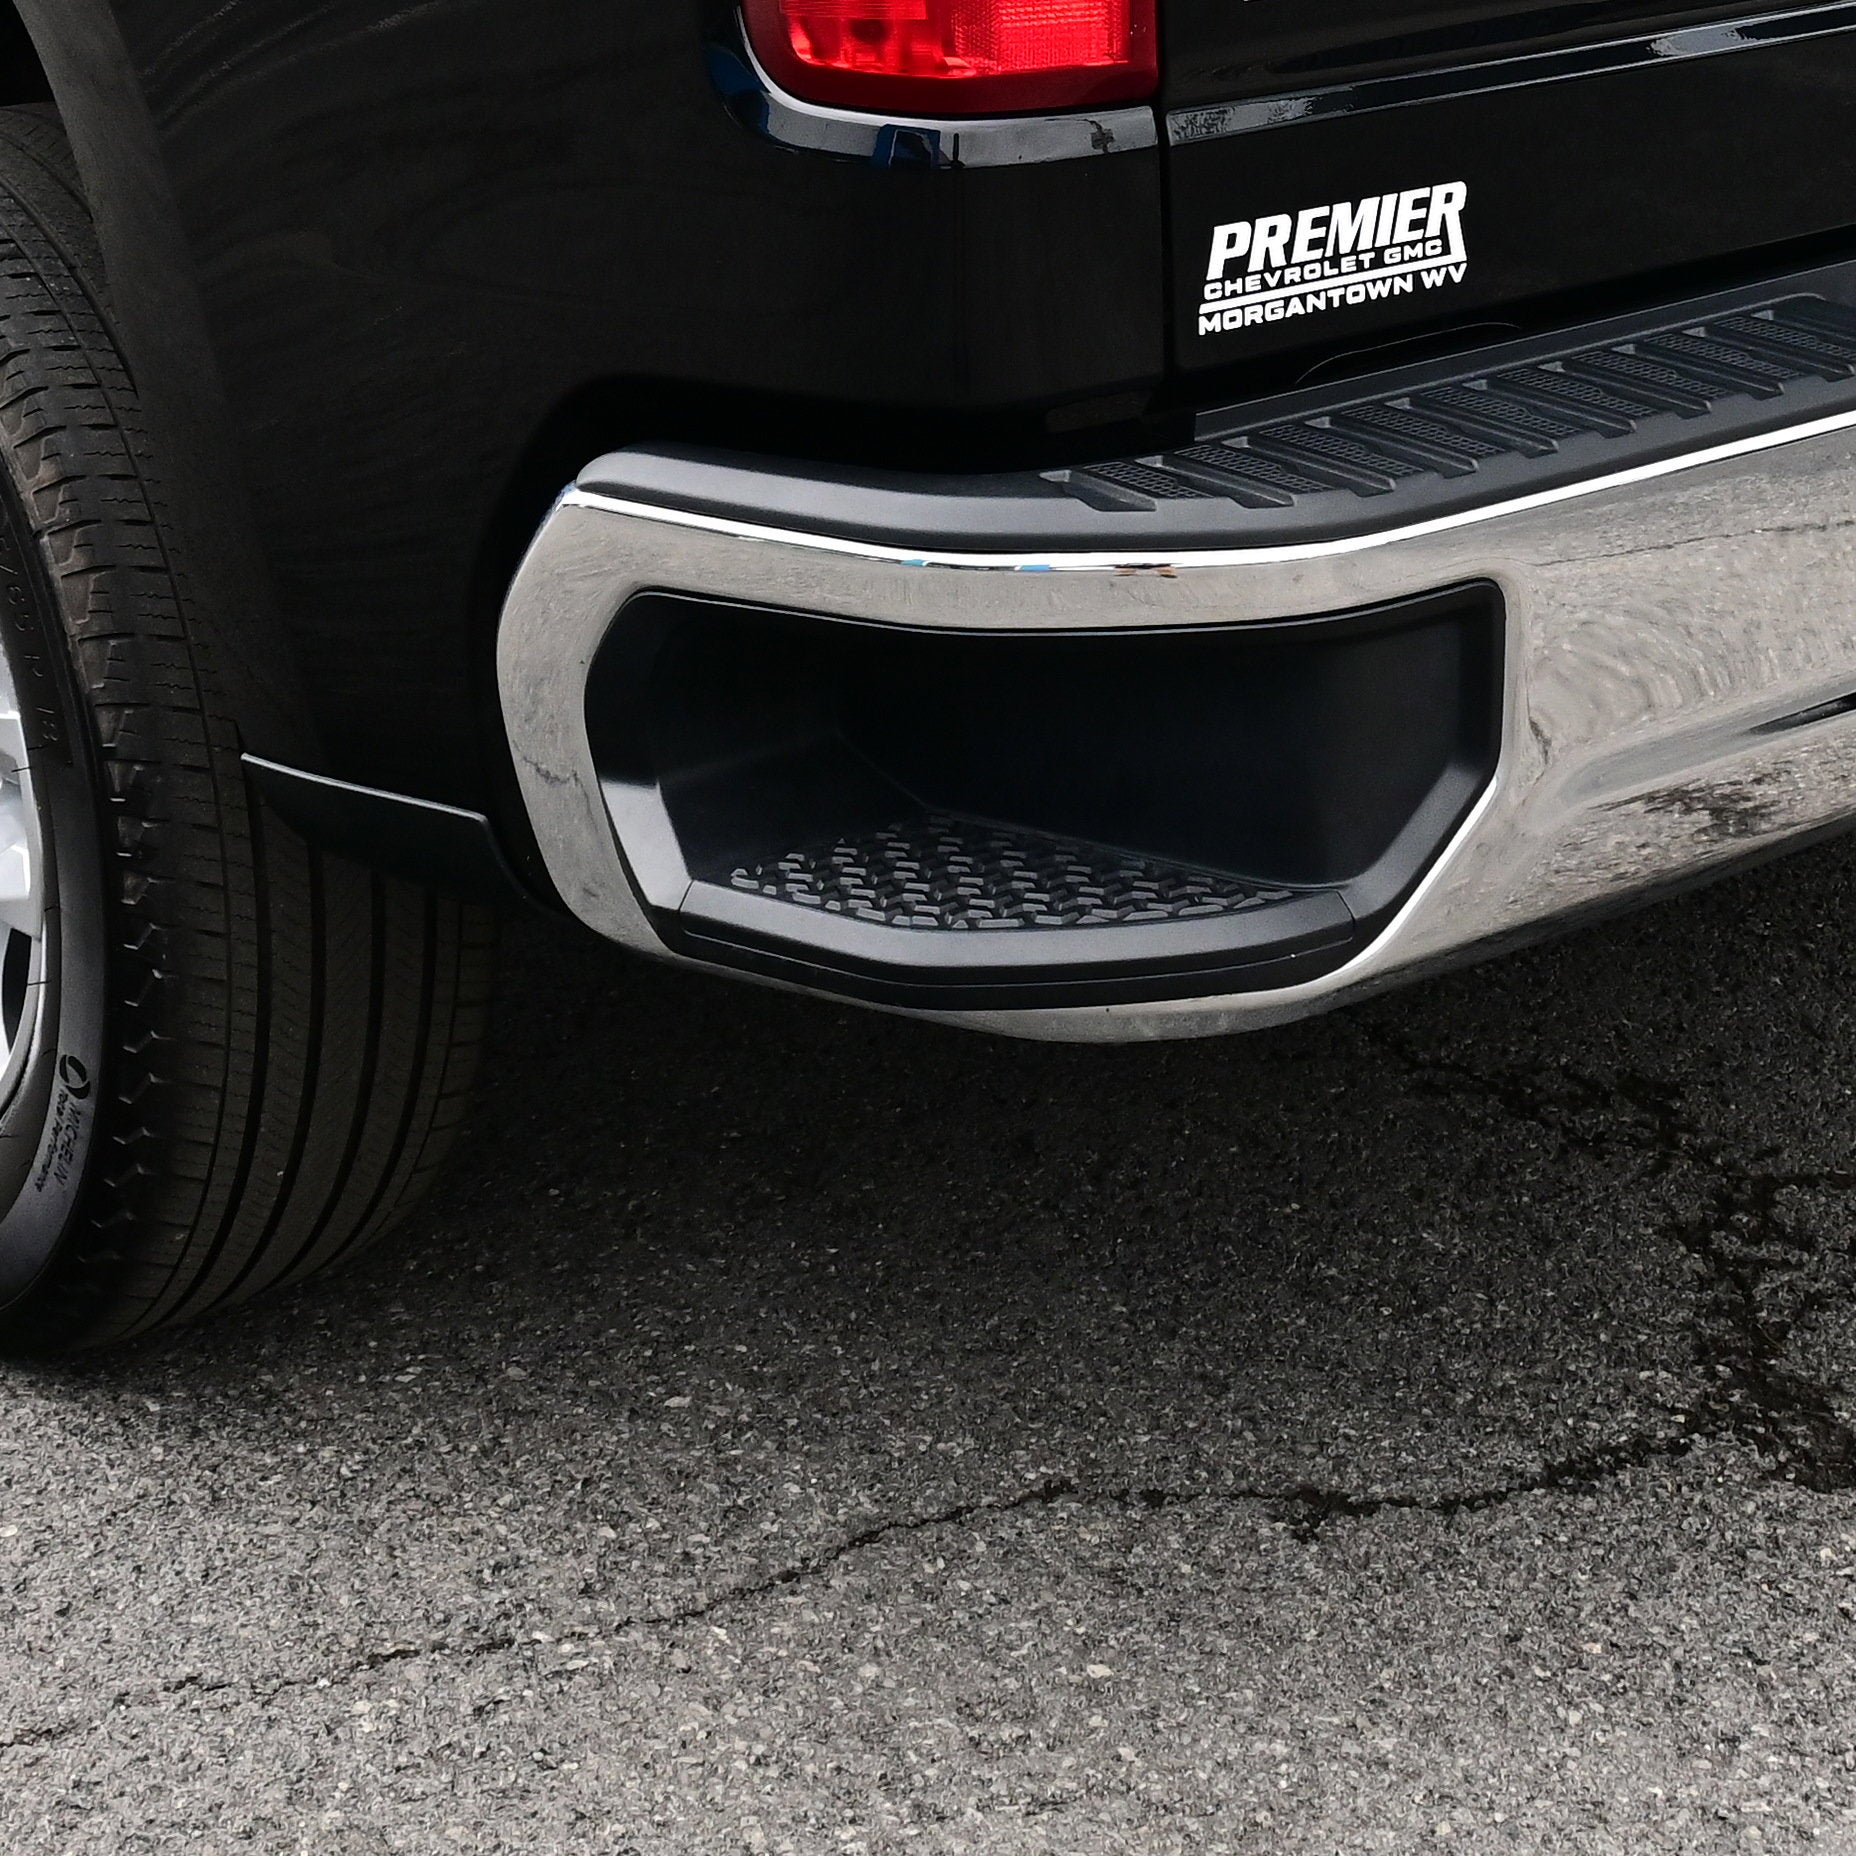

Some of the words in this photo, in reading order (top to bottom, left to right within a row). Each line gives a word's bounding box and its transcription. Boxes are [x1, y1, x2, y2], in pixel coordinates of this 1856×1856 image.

[1205, 180, 1467, 281] PREMIER
[1198, 276, 1414, 336] MORGANTOWN
[1422, 262, 1468, 290] WV
[1203, 251, 1376, 301] CHEVROLET
[1383, 238, 1444, 265] GMC
